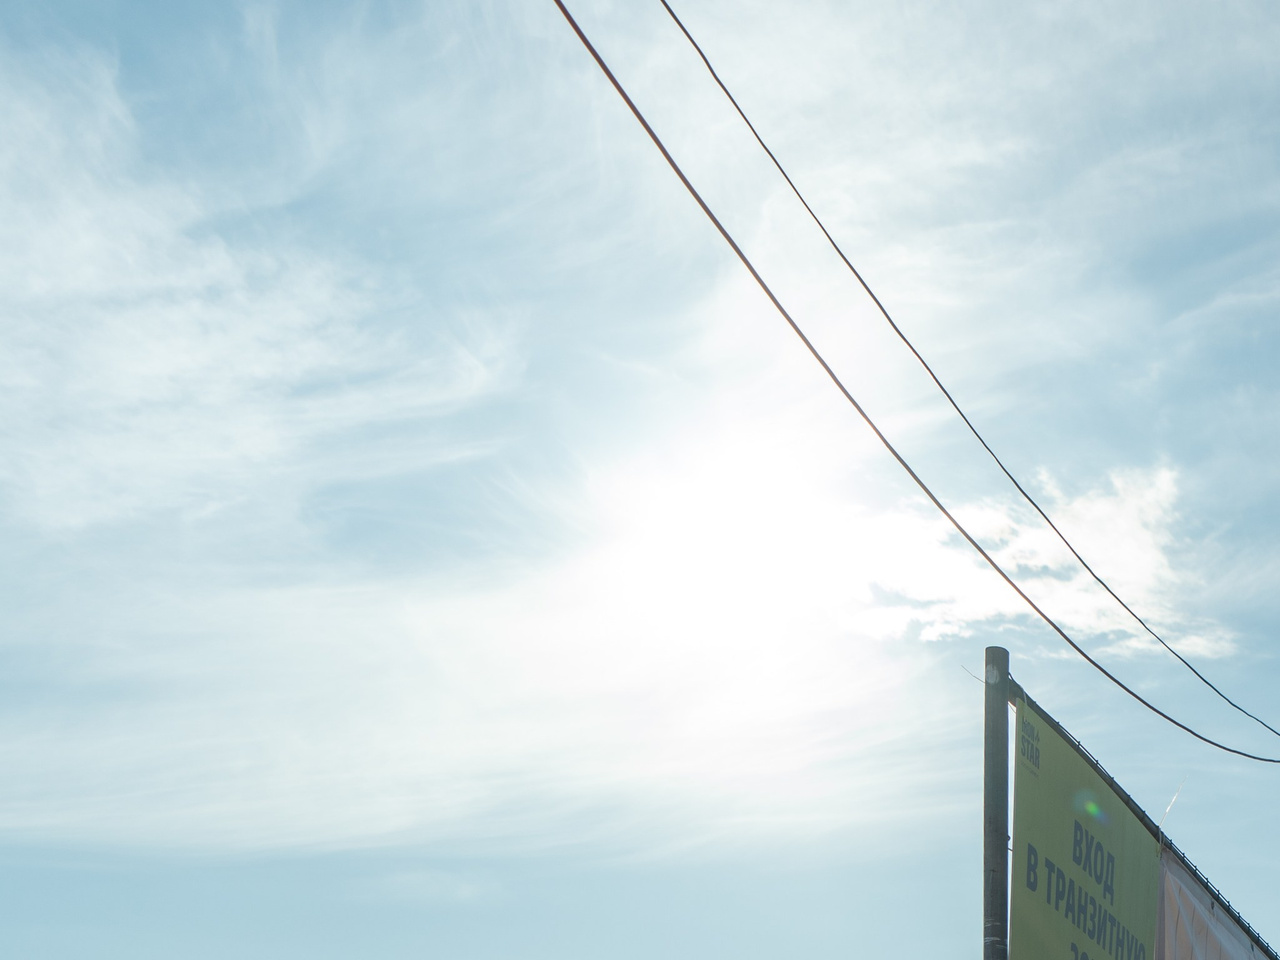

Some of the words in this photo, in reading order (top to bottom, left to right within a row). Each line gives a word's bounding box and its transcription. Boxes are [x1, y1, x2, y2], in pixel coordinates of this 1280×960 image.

[1021, 734, 1040, 770] STAR
[1026, 843, 1039, 892] В
[1072, 819, 1116, 907] ВХОД
